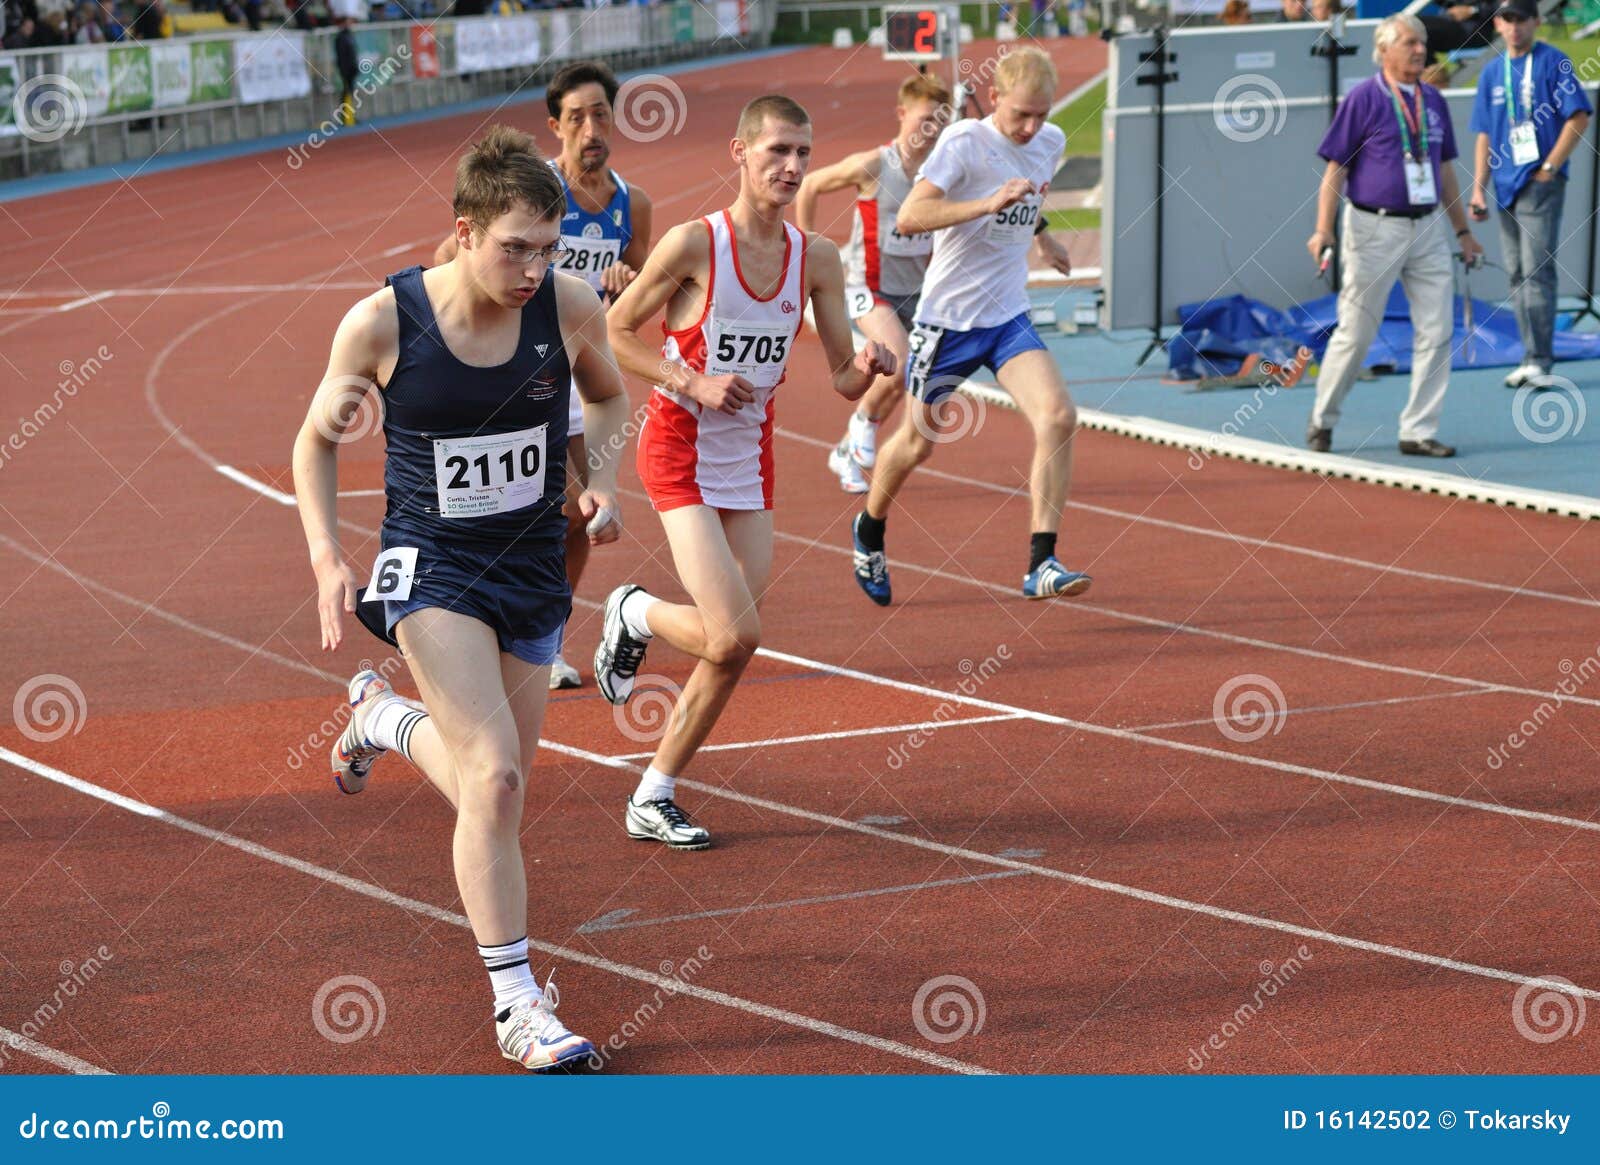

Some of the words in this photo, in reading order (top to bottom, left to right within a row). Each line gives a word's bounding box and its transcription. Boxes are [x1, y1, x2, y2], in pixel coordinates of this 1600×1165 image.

[913, 11, 937, 54] 2
[561, 248, 614, 272] 2810
[855, 293, 867, 312] 2
[716, 333, 788, 364] 5703
[445, 444, 540, 489] 2110
[376, 558, 403, 593] 6
